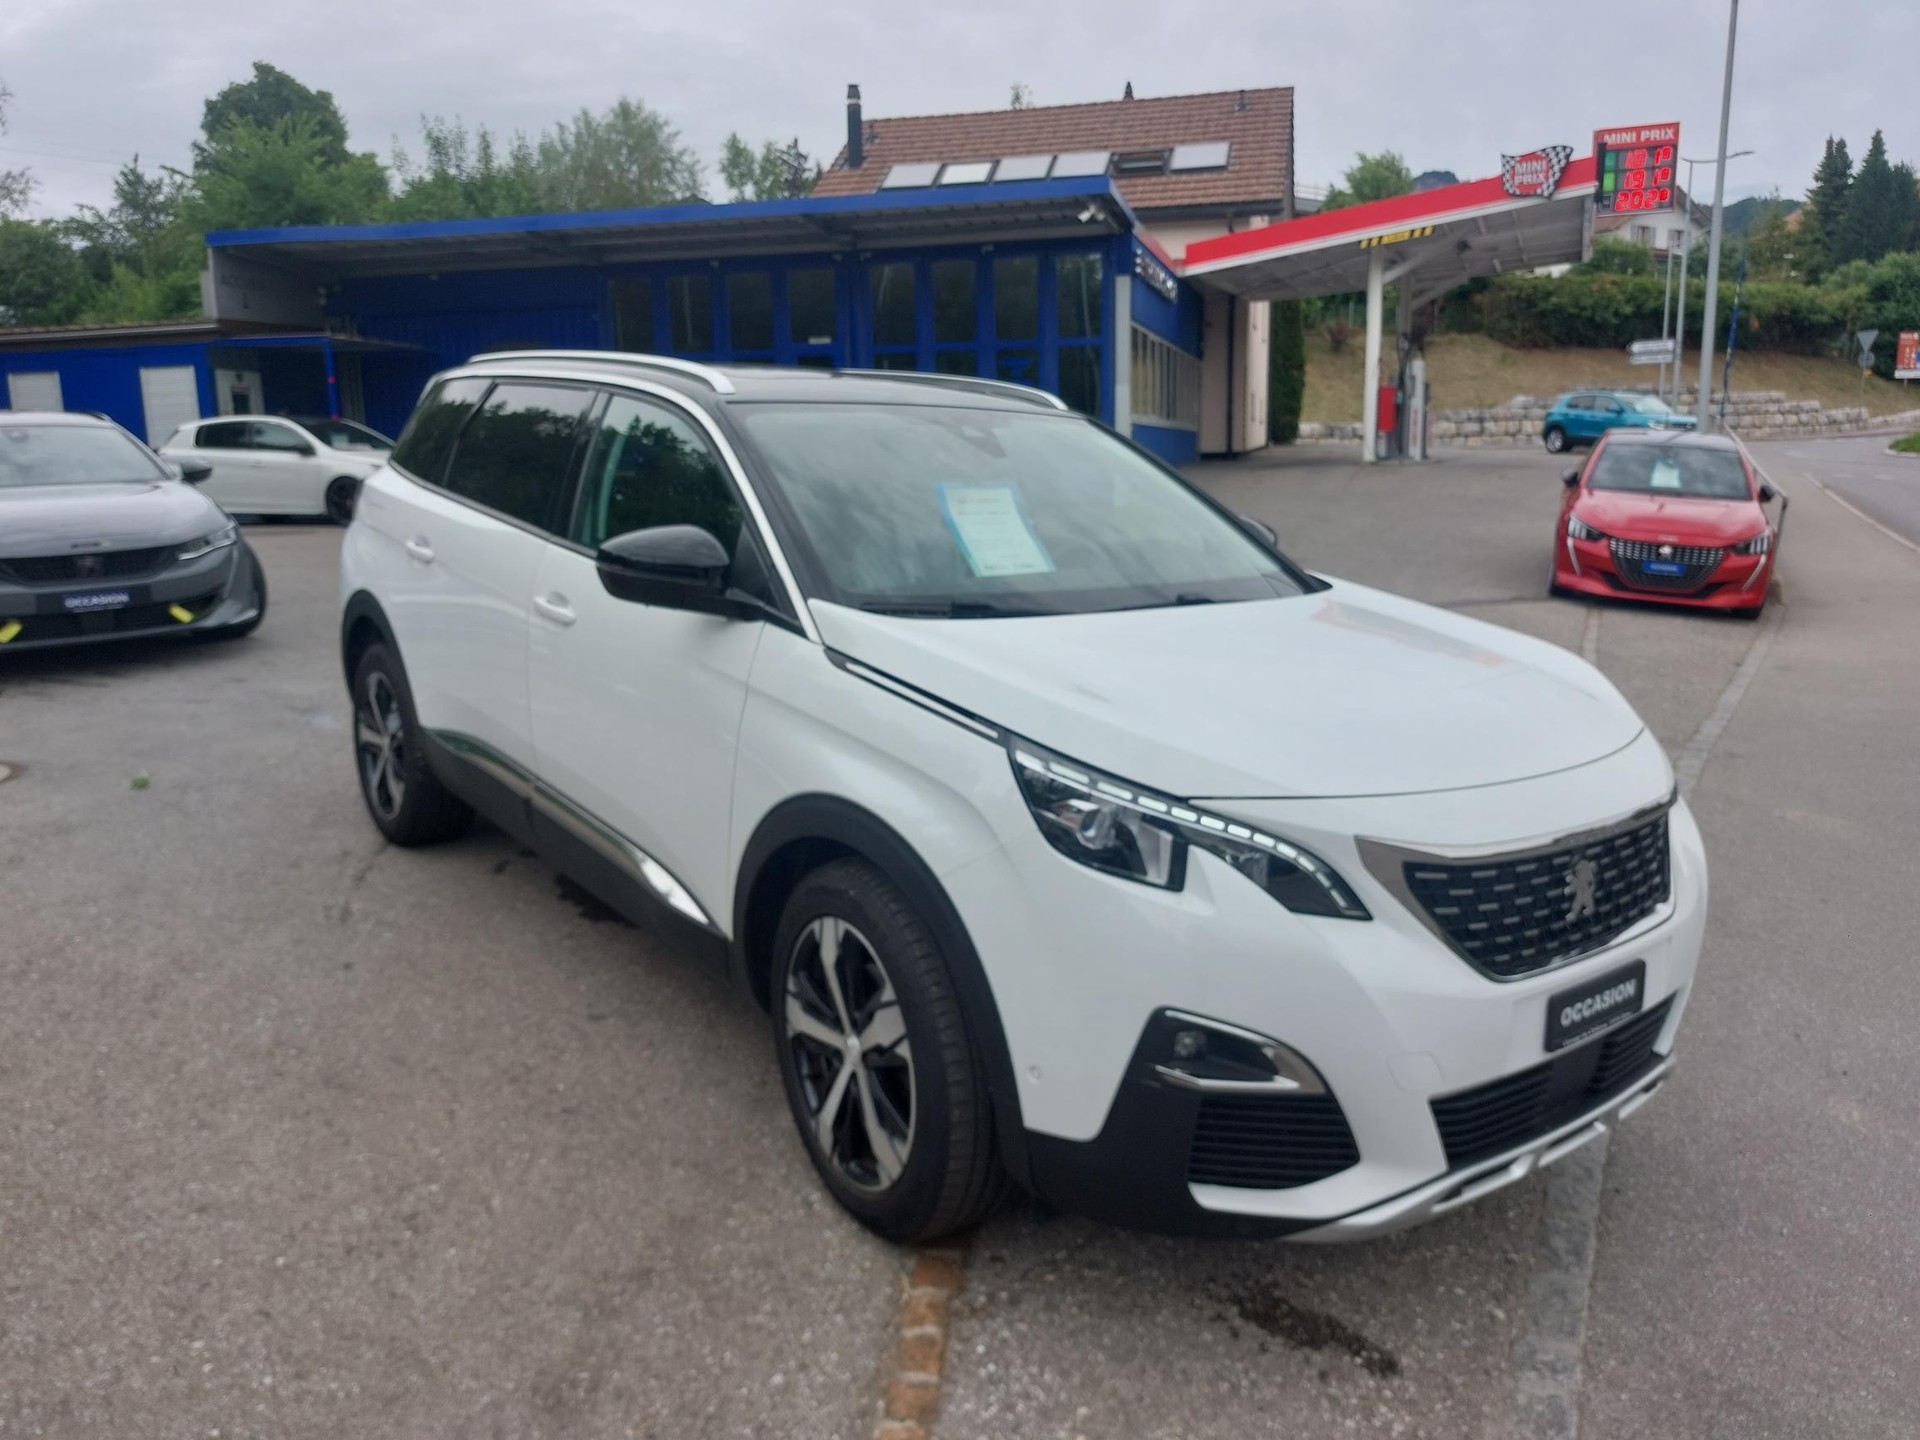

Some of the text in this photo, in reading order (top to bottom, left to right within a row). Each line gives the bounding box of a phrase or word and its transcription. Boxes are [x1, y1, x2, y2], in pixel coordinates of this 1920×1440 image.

[1603, 127, 1675, 144] MINI PRIX
[1514, 160, 1546, 175] MINI
[1514, 172, 1548, 186] PRIX
[1560, 978, 1636, 1027] OCCASION
